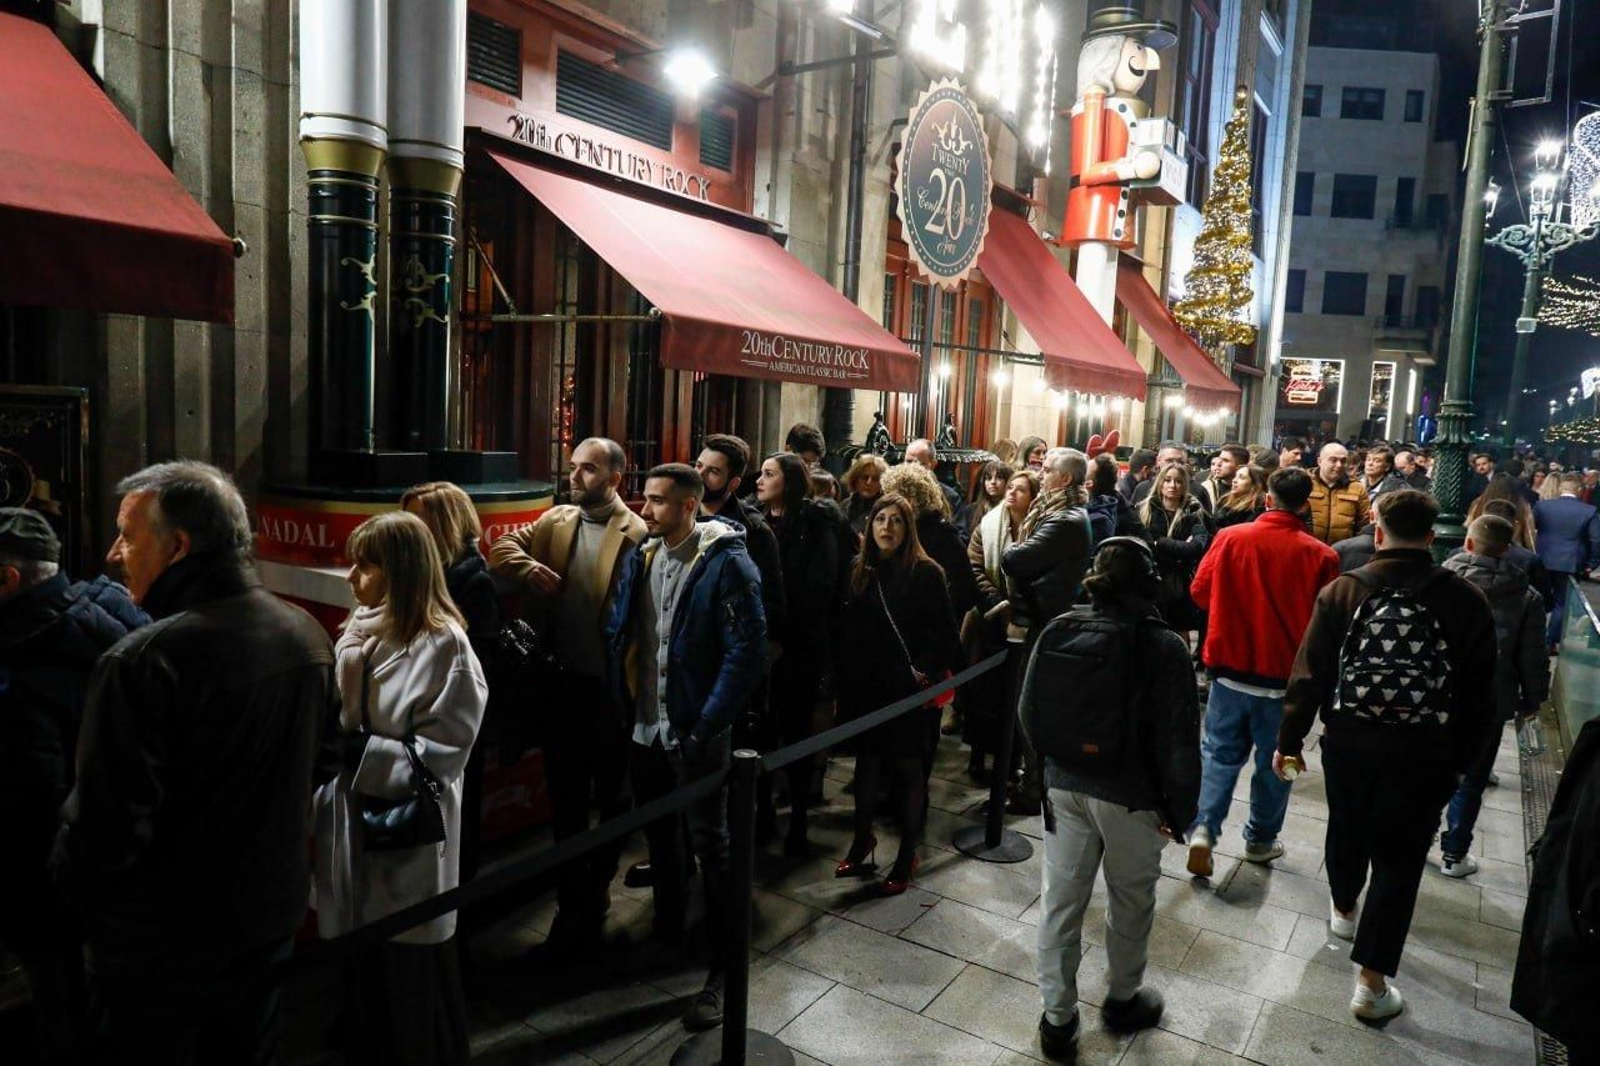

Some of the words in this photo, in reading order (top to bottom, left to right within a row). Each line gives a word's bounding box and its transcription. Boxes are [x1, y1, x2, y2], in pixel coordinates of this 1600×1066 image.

[507, 113, 551, 151] 20th
[555, 132, 659, 183] CENTURY
[661, 164, 711, 203] ROCK
[932, 143, 969, 175] TWENTY
[925, 168, 966, 240] 20
[769, 361, 806, 375] AMERICAN
[806, 366, 832, 378] CLASSIC
[833, 370, 847, 379] BAR
[258, 515, 335, 549] NADAL
